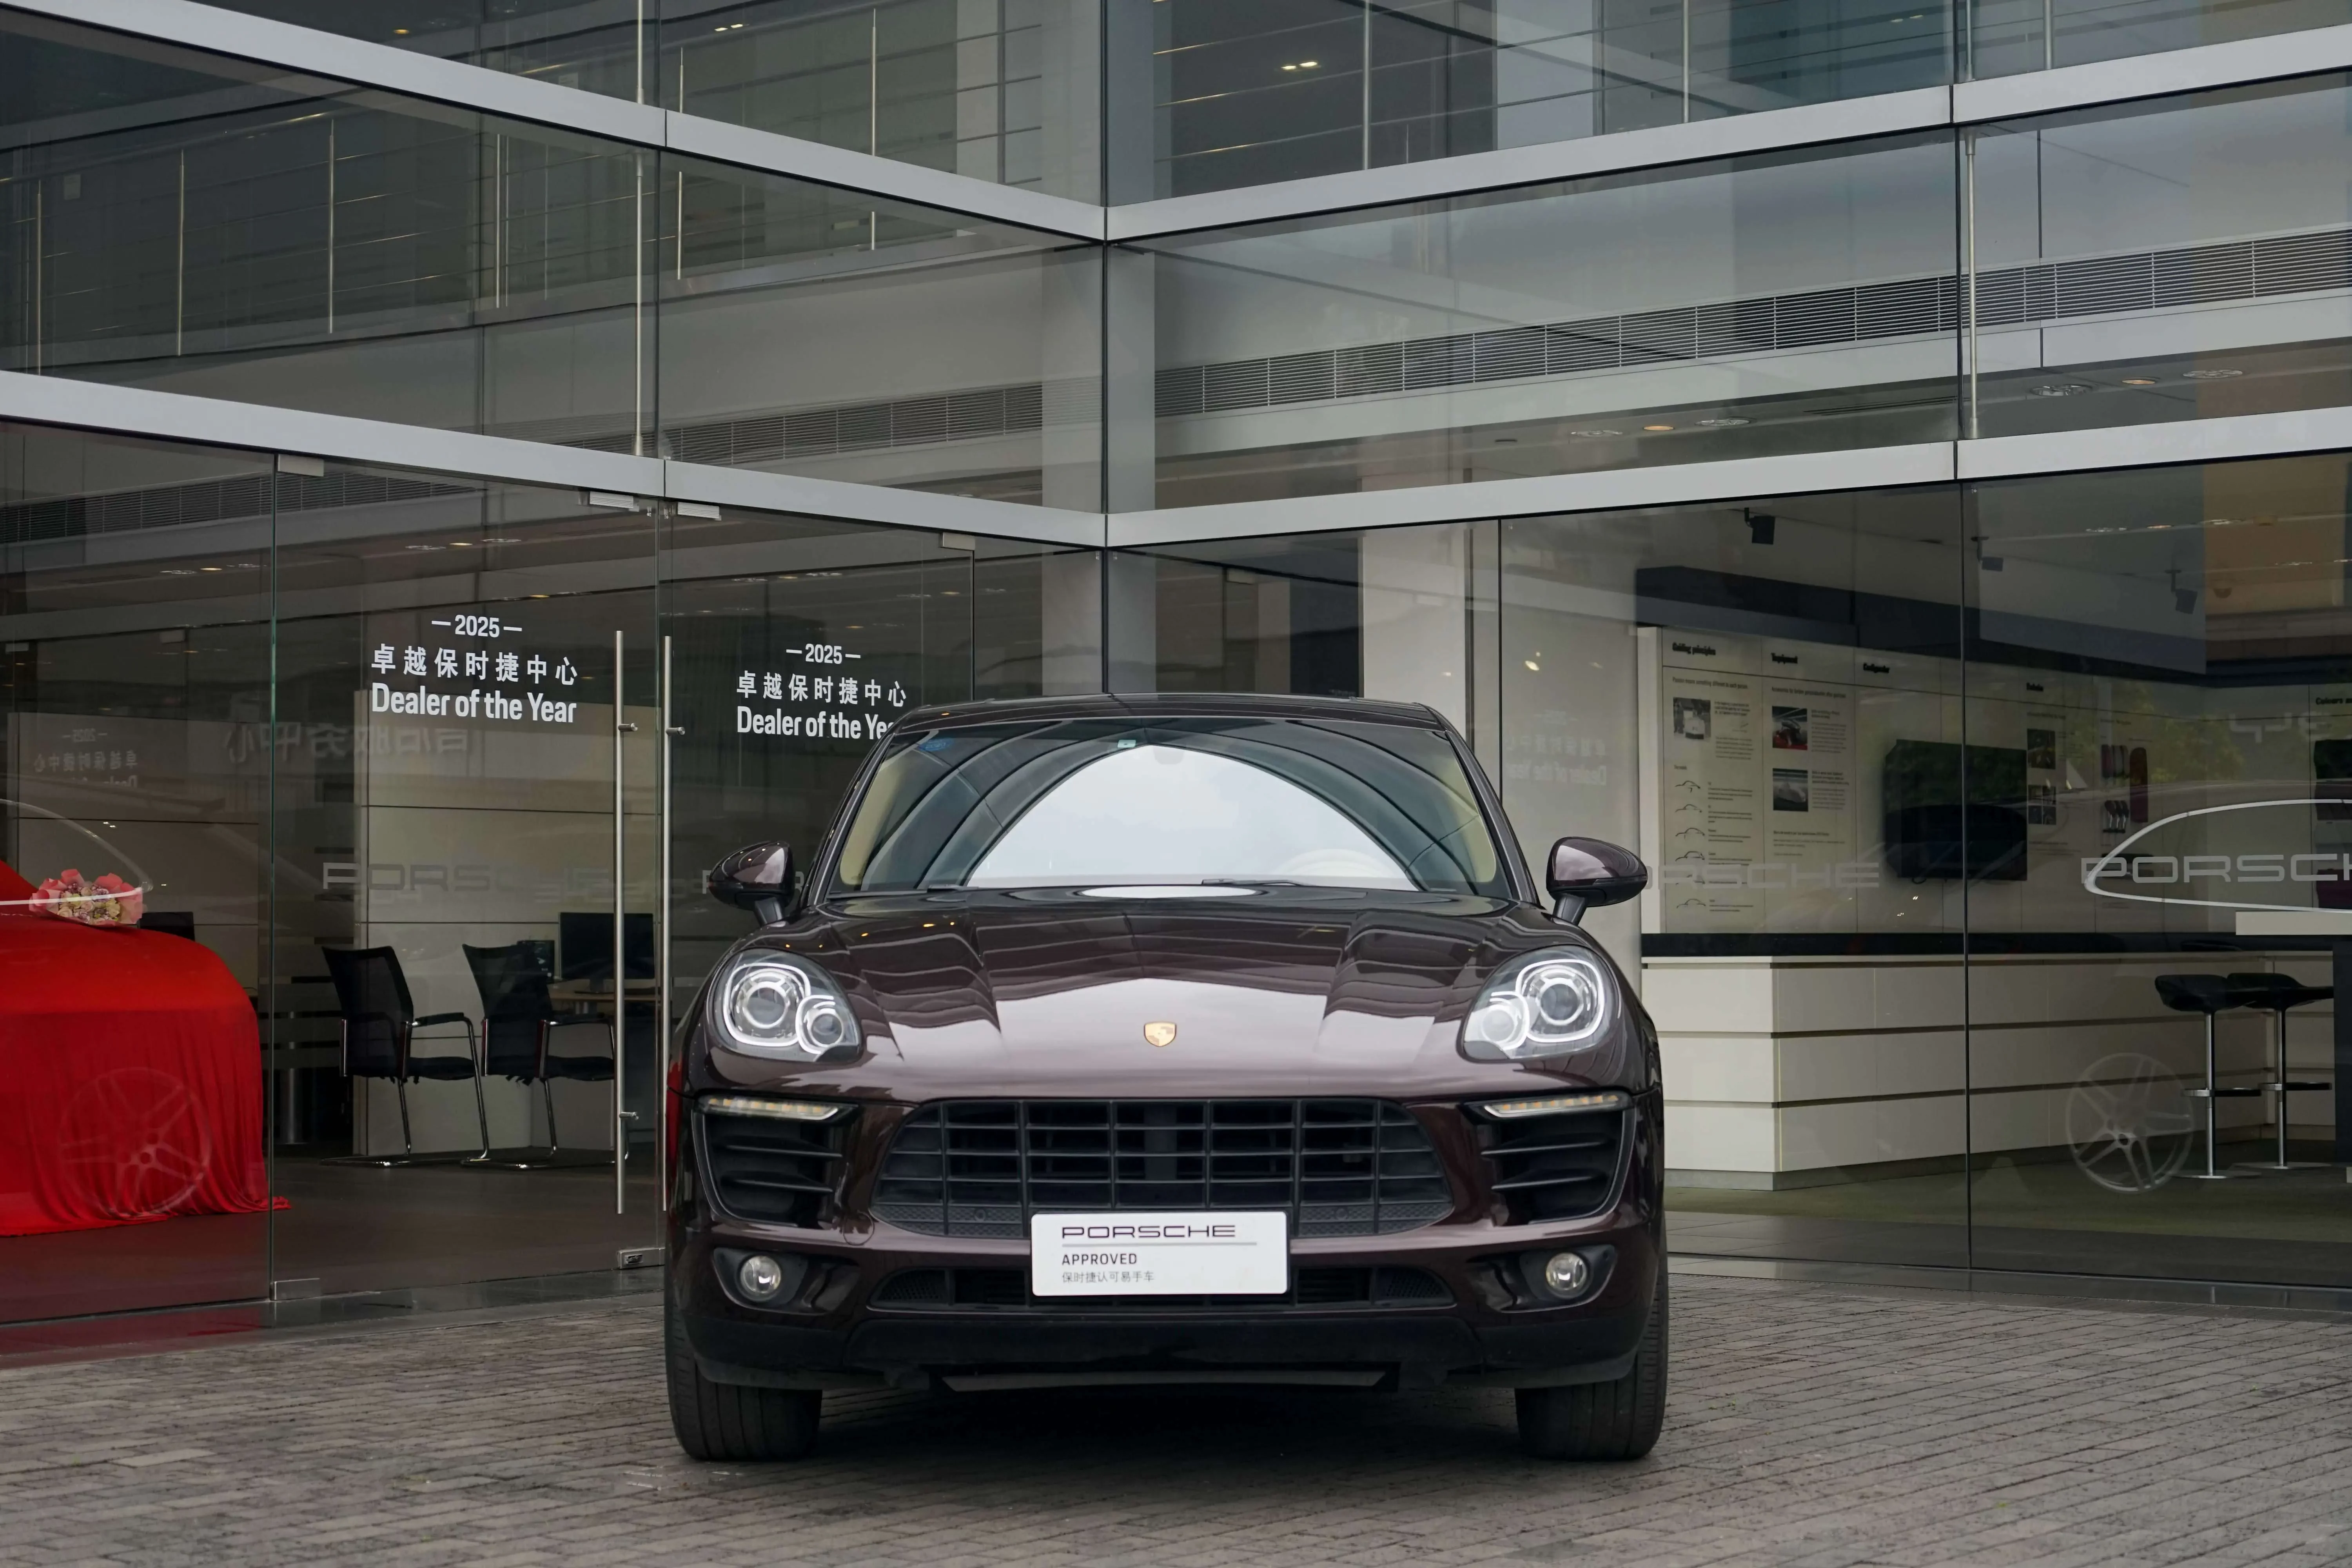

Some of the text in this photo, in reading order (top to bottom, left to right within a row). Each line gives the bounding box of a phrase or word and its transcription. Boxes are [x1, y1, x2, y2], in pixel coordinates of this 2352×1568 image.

[372, 643, 578, 686] 卓越保时捷中心
[372, 682, 577, 723] Dealer of the Year
[737, 670, 906, 707] 卓越保时捷中心
[737, 706, 802, 736] Dealer
[806, 711, 826, 737] of
[829, 712, 862, 739] the
[1062, 1225, 1236, 1239] PORSCHE
[1062, 1253, 1138, 1265] APPROVED
[1062, 1270, 1154, 1283] 保时捷认可易手车
